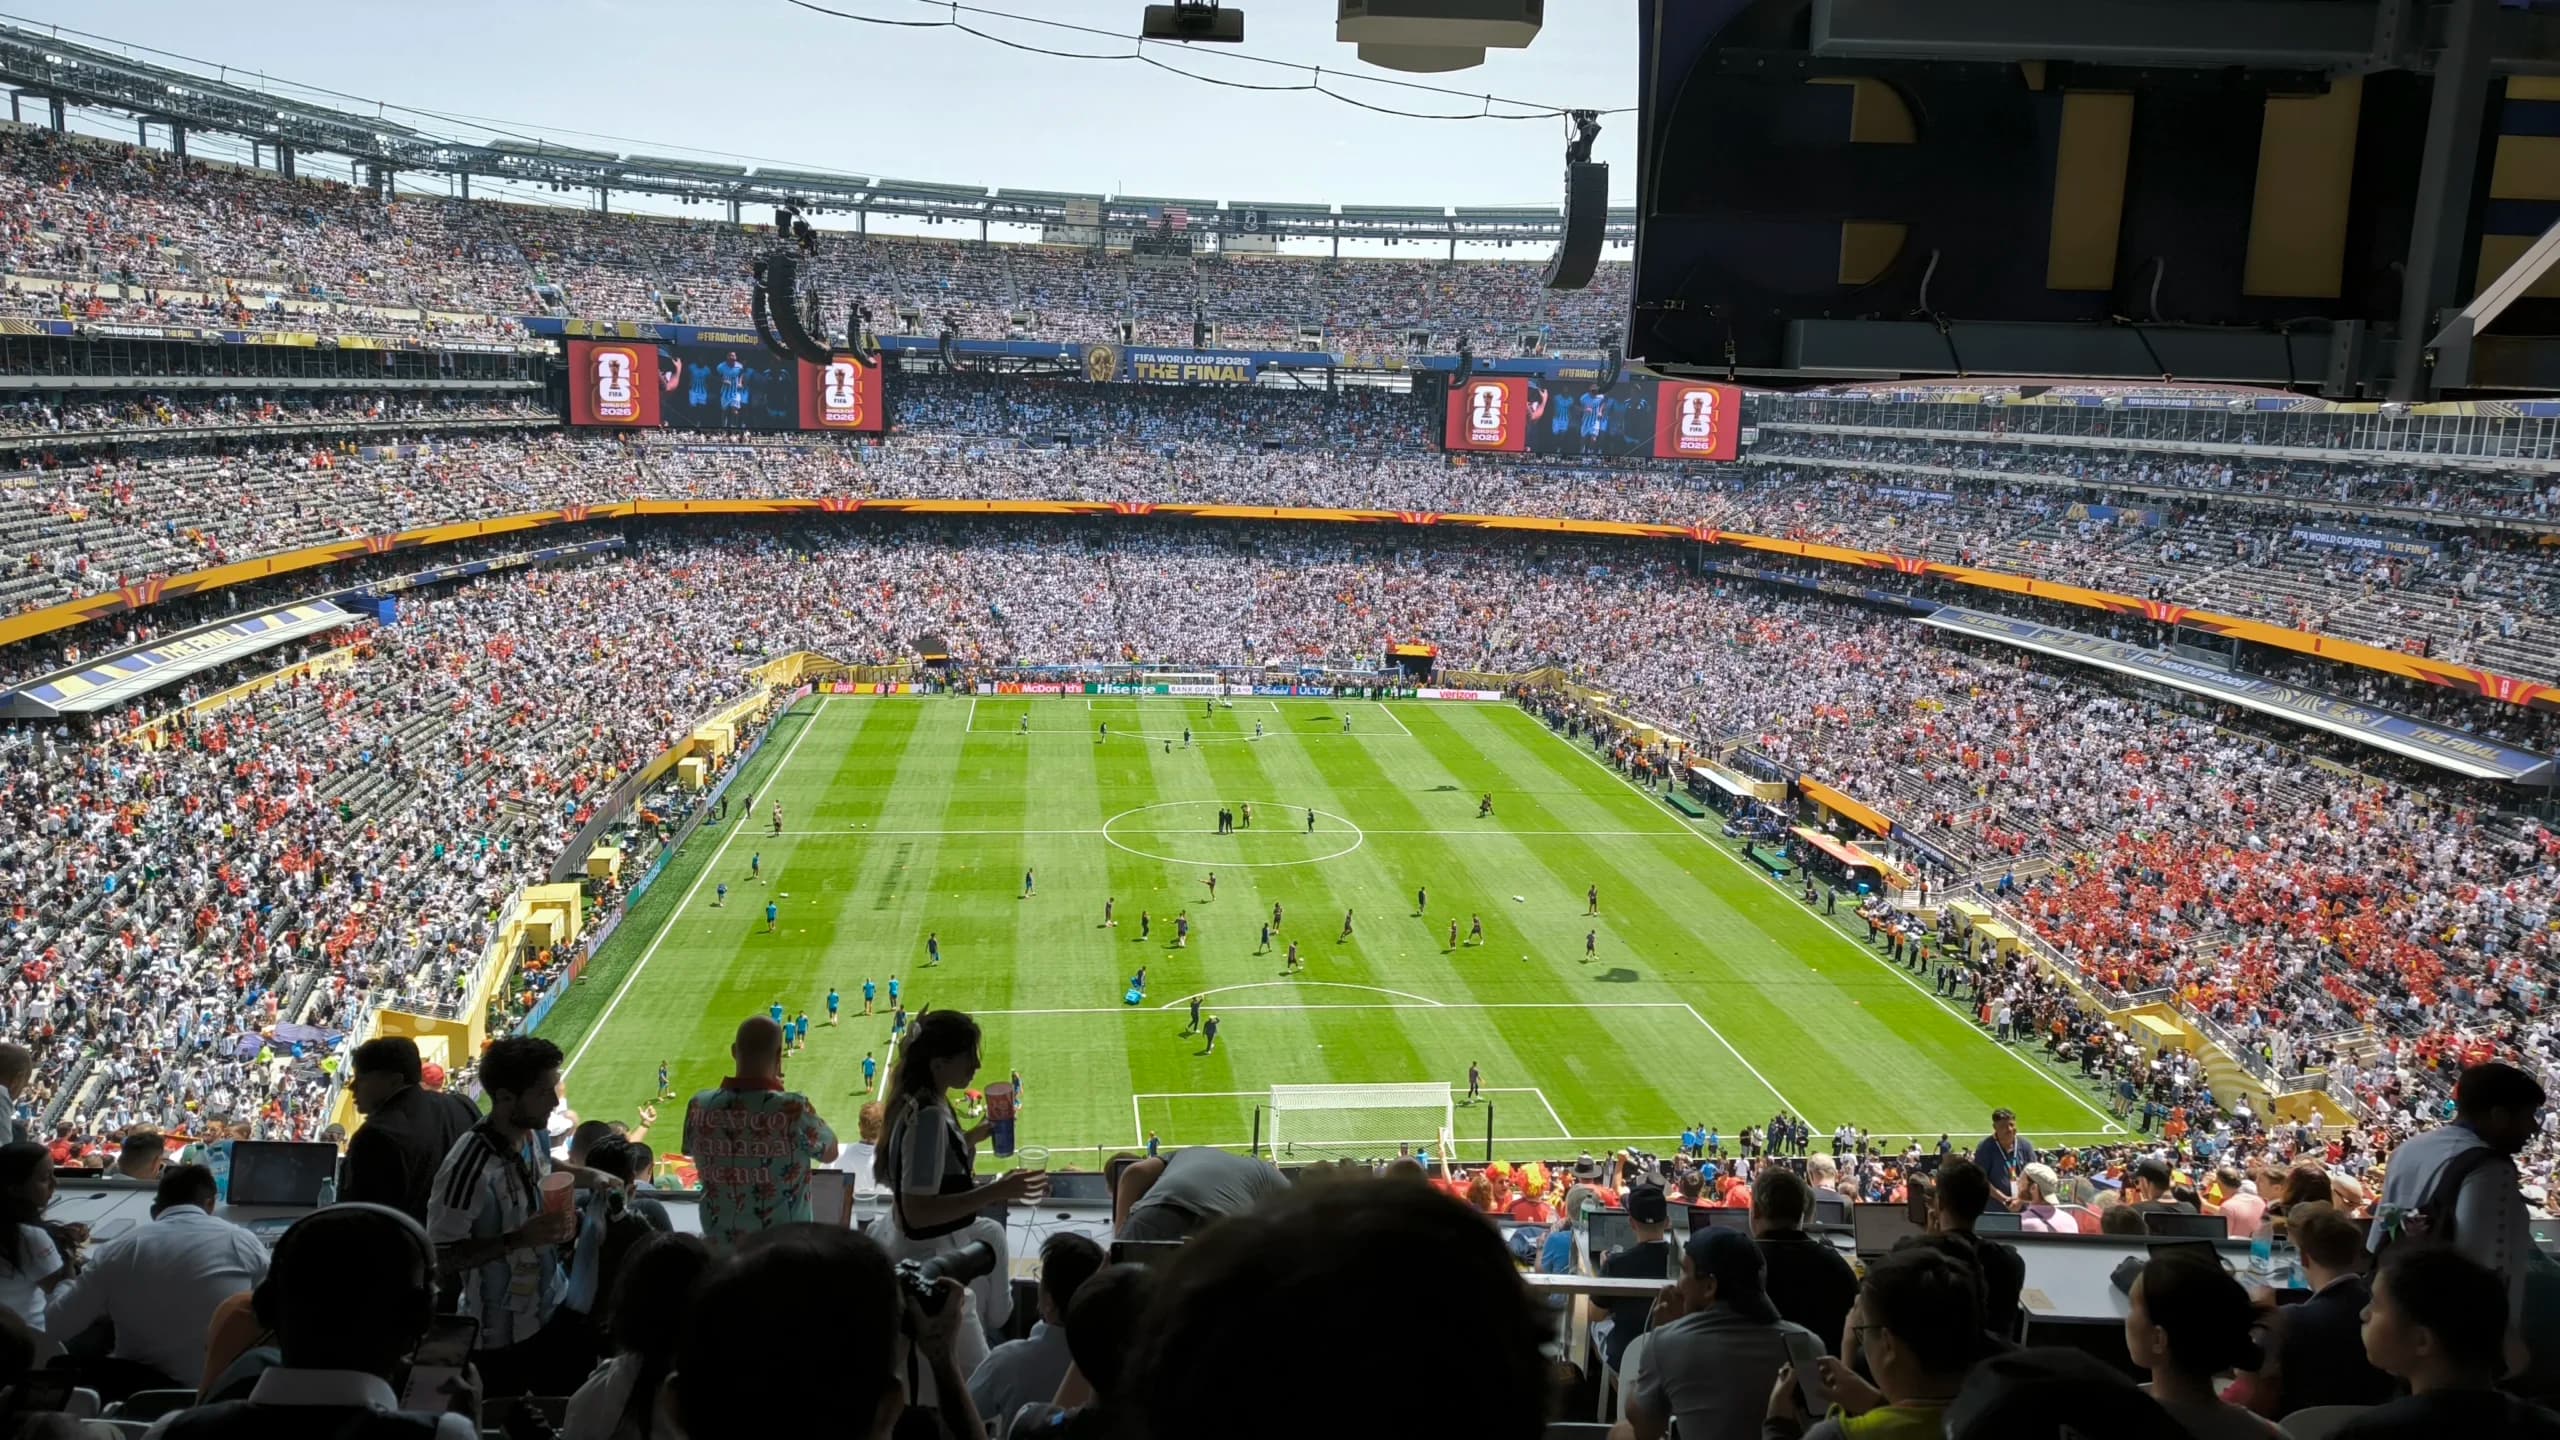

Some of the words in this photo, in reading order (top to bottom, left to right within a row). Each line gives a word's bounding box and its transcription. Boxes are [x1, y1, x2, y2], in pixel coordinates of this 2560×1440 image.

[697, 332, 758, 345] #FIFAWorldCup
[1134, 353, 1155, 362] FIFA
[1157, 355, 1192, 364] WORLD
[1195, 356, 1214, 364] CUP
[1215, 356, 1251, 366] 2026
[1134, 363, 1179, 379] THE
[1184, 365, 1250, 381] FINAL
[1559, 368, 1600, 378] #FIFAWorl
[600, 408, 632, 416] 2026
[1680, 441, 1709, 449] 2026
[2292, 530, 2309, 540] FIFA
[2309, 532, 2337, 543] WORLD
[2337, 535, 2353, 546] CUP
[2353, 538, 2382, 549] 2026
[2384, 541, 2404, 552] THE
[2405, 544, 2431, 556] FINA
[150, 642, 192, 660] THE
[184, 628, 243, 651] FINAL
[2209, 674, 2248, 687] 2026
[1022, 683, 1083, 693] McDonld's
[1097, 683, 1156, 694] Hisense
[1300, 686, 1333, 696] ULTRA
[1440, 690, 1478, 699] verizon
[2442, 738, 2501, 760] FINAL
